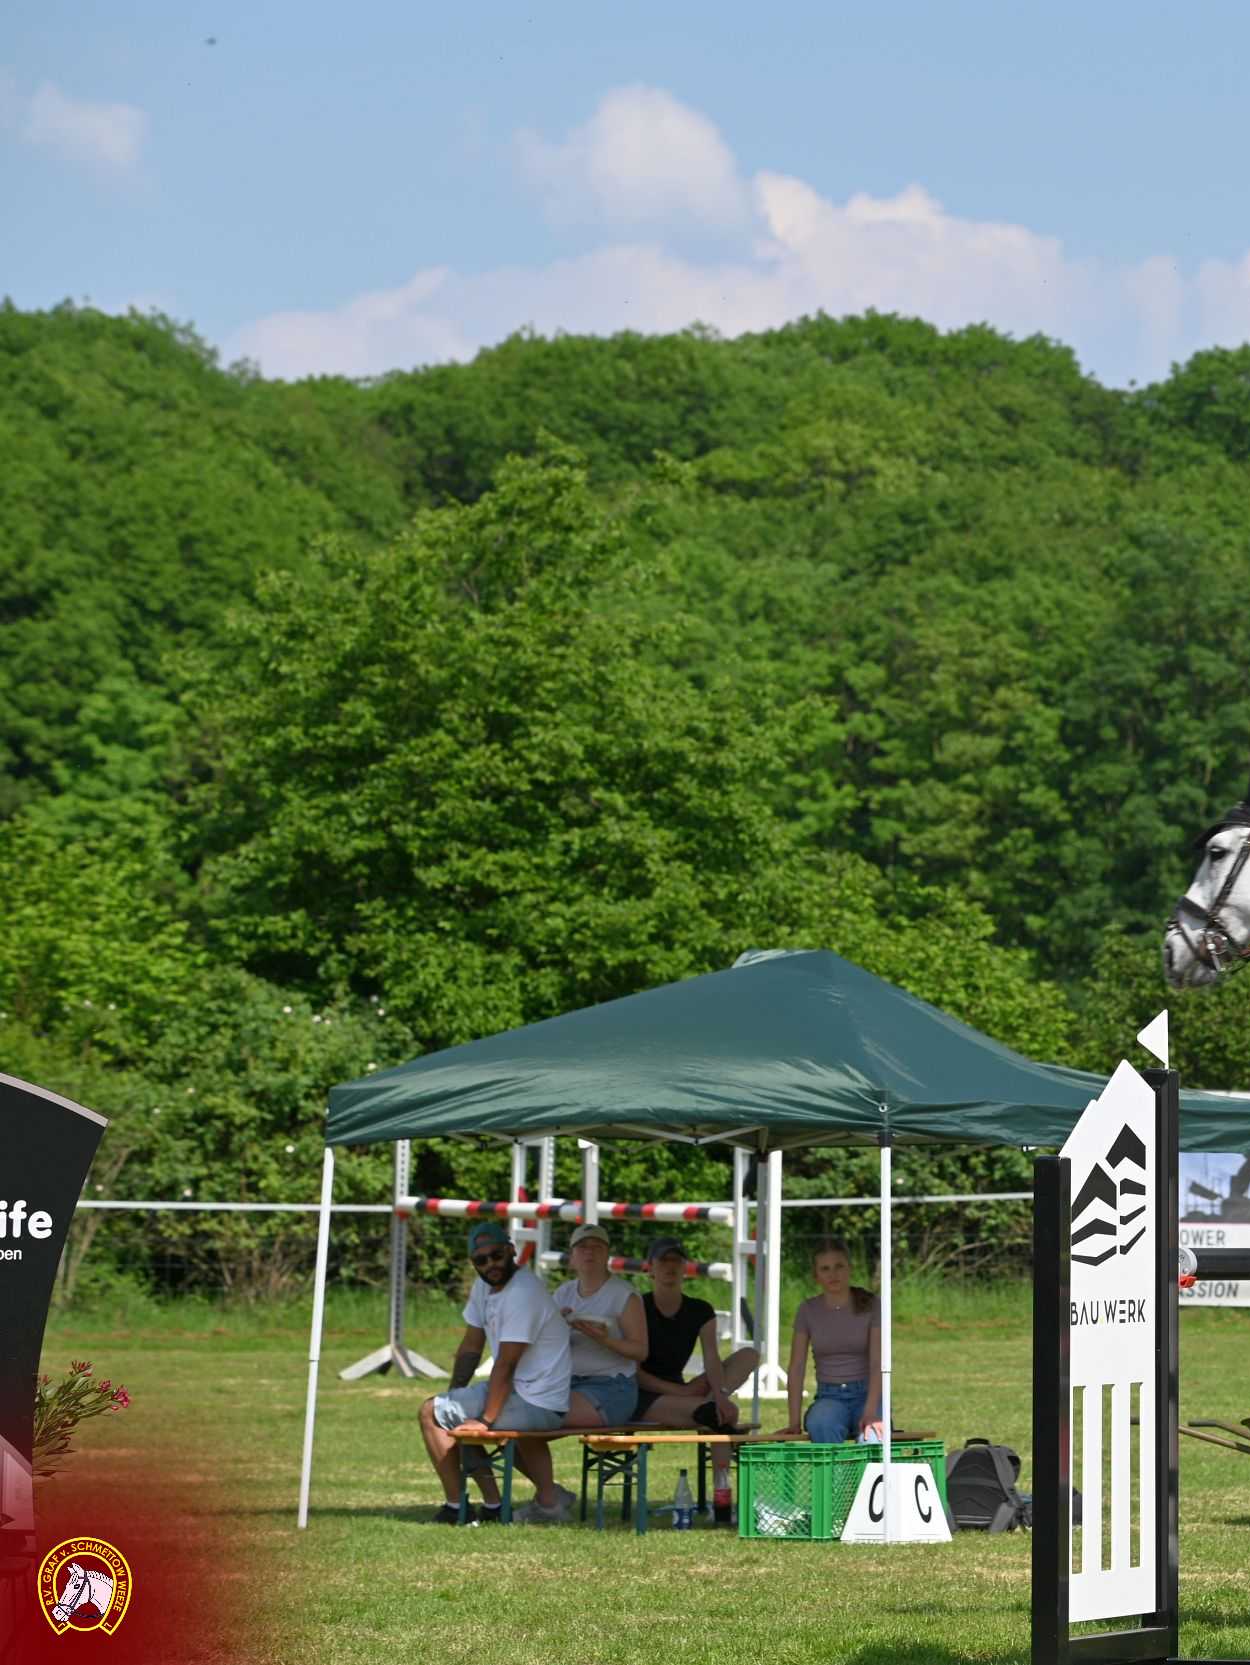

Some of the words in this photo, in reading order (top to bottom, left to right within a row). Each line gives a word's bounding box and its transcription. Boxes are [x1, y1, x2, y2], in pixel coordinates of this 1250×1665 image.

[1179, 1230, 1226, 1246] OWER
[1179, 1282, 1239, 1298] SSION
[914, 1474, 932, 1523] C
